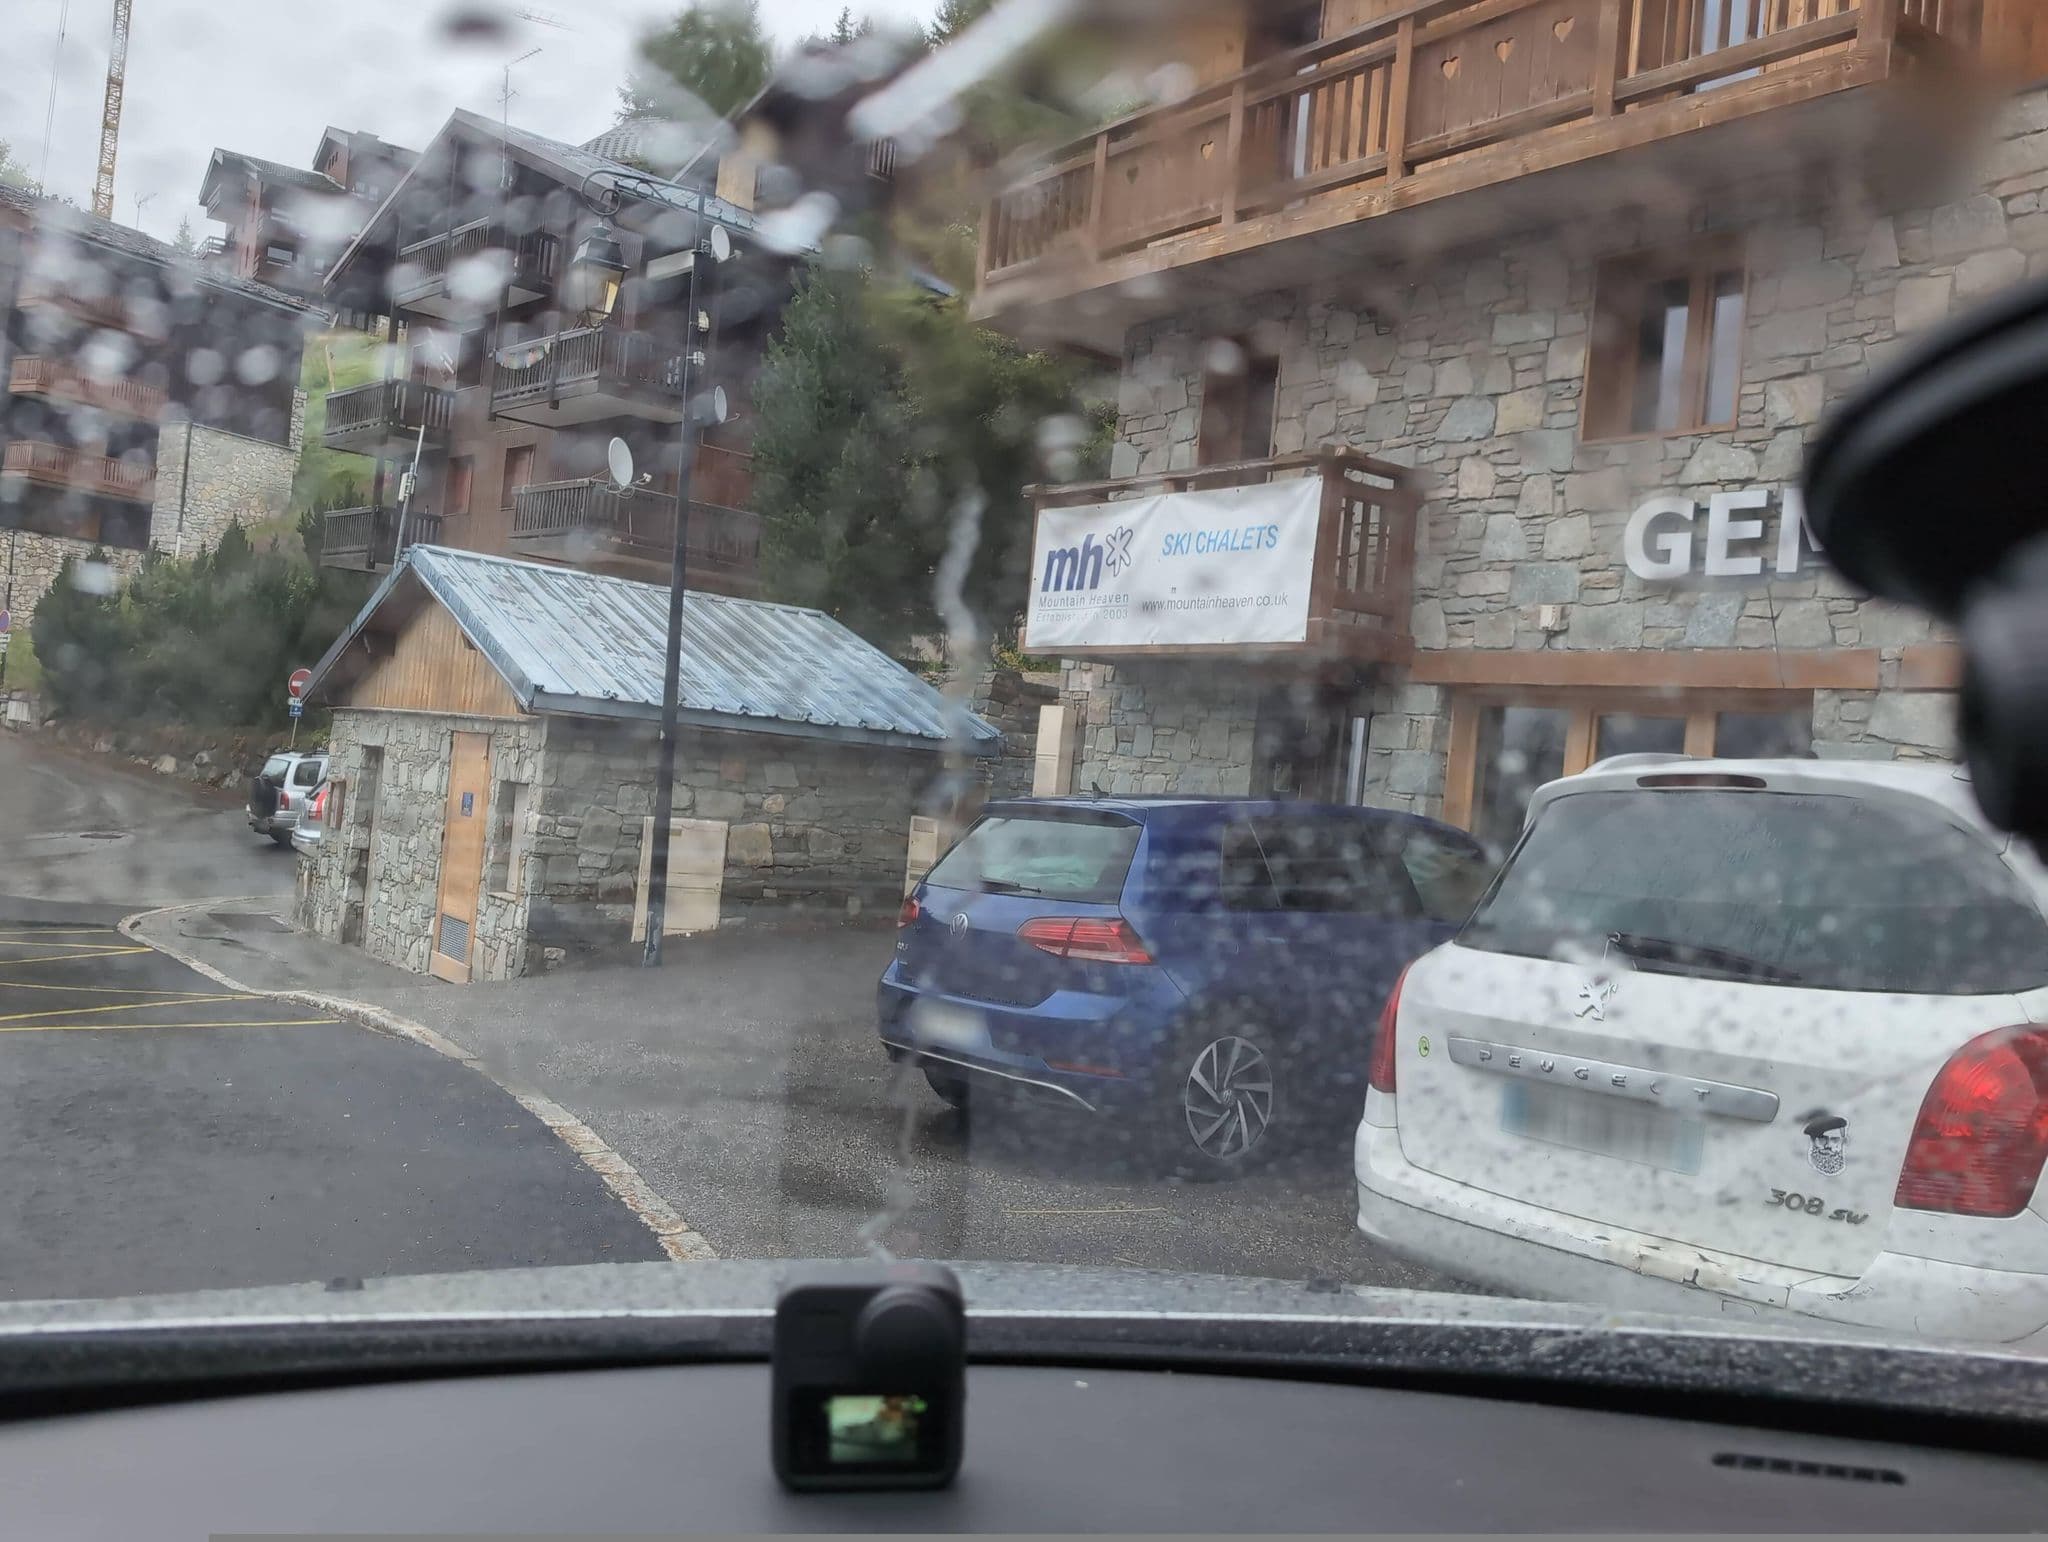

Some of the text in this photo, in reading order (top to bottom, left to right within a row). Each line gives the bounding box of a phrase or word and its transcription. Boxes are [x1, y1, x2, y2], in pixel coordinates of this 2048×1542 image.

[1162, 524, 1279, 556] SKI CHALETS
[1041, 534, 1103, 592] mh
[1038, 593, 1129, 609] Mountain Heaven
[1142, 592, 1288, 612] www.mountainheaven.co.uk
[1103, 607, 1129, 620] 2003
[1764, 1188, 1824, 1216] 308
